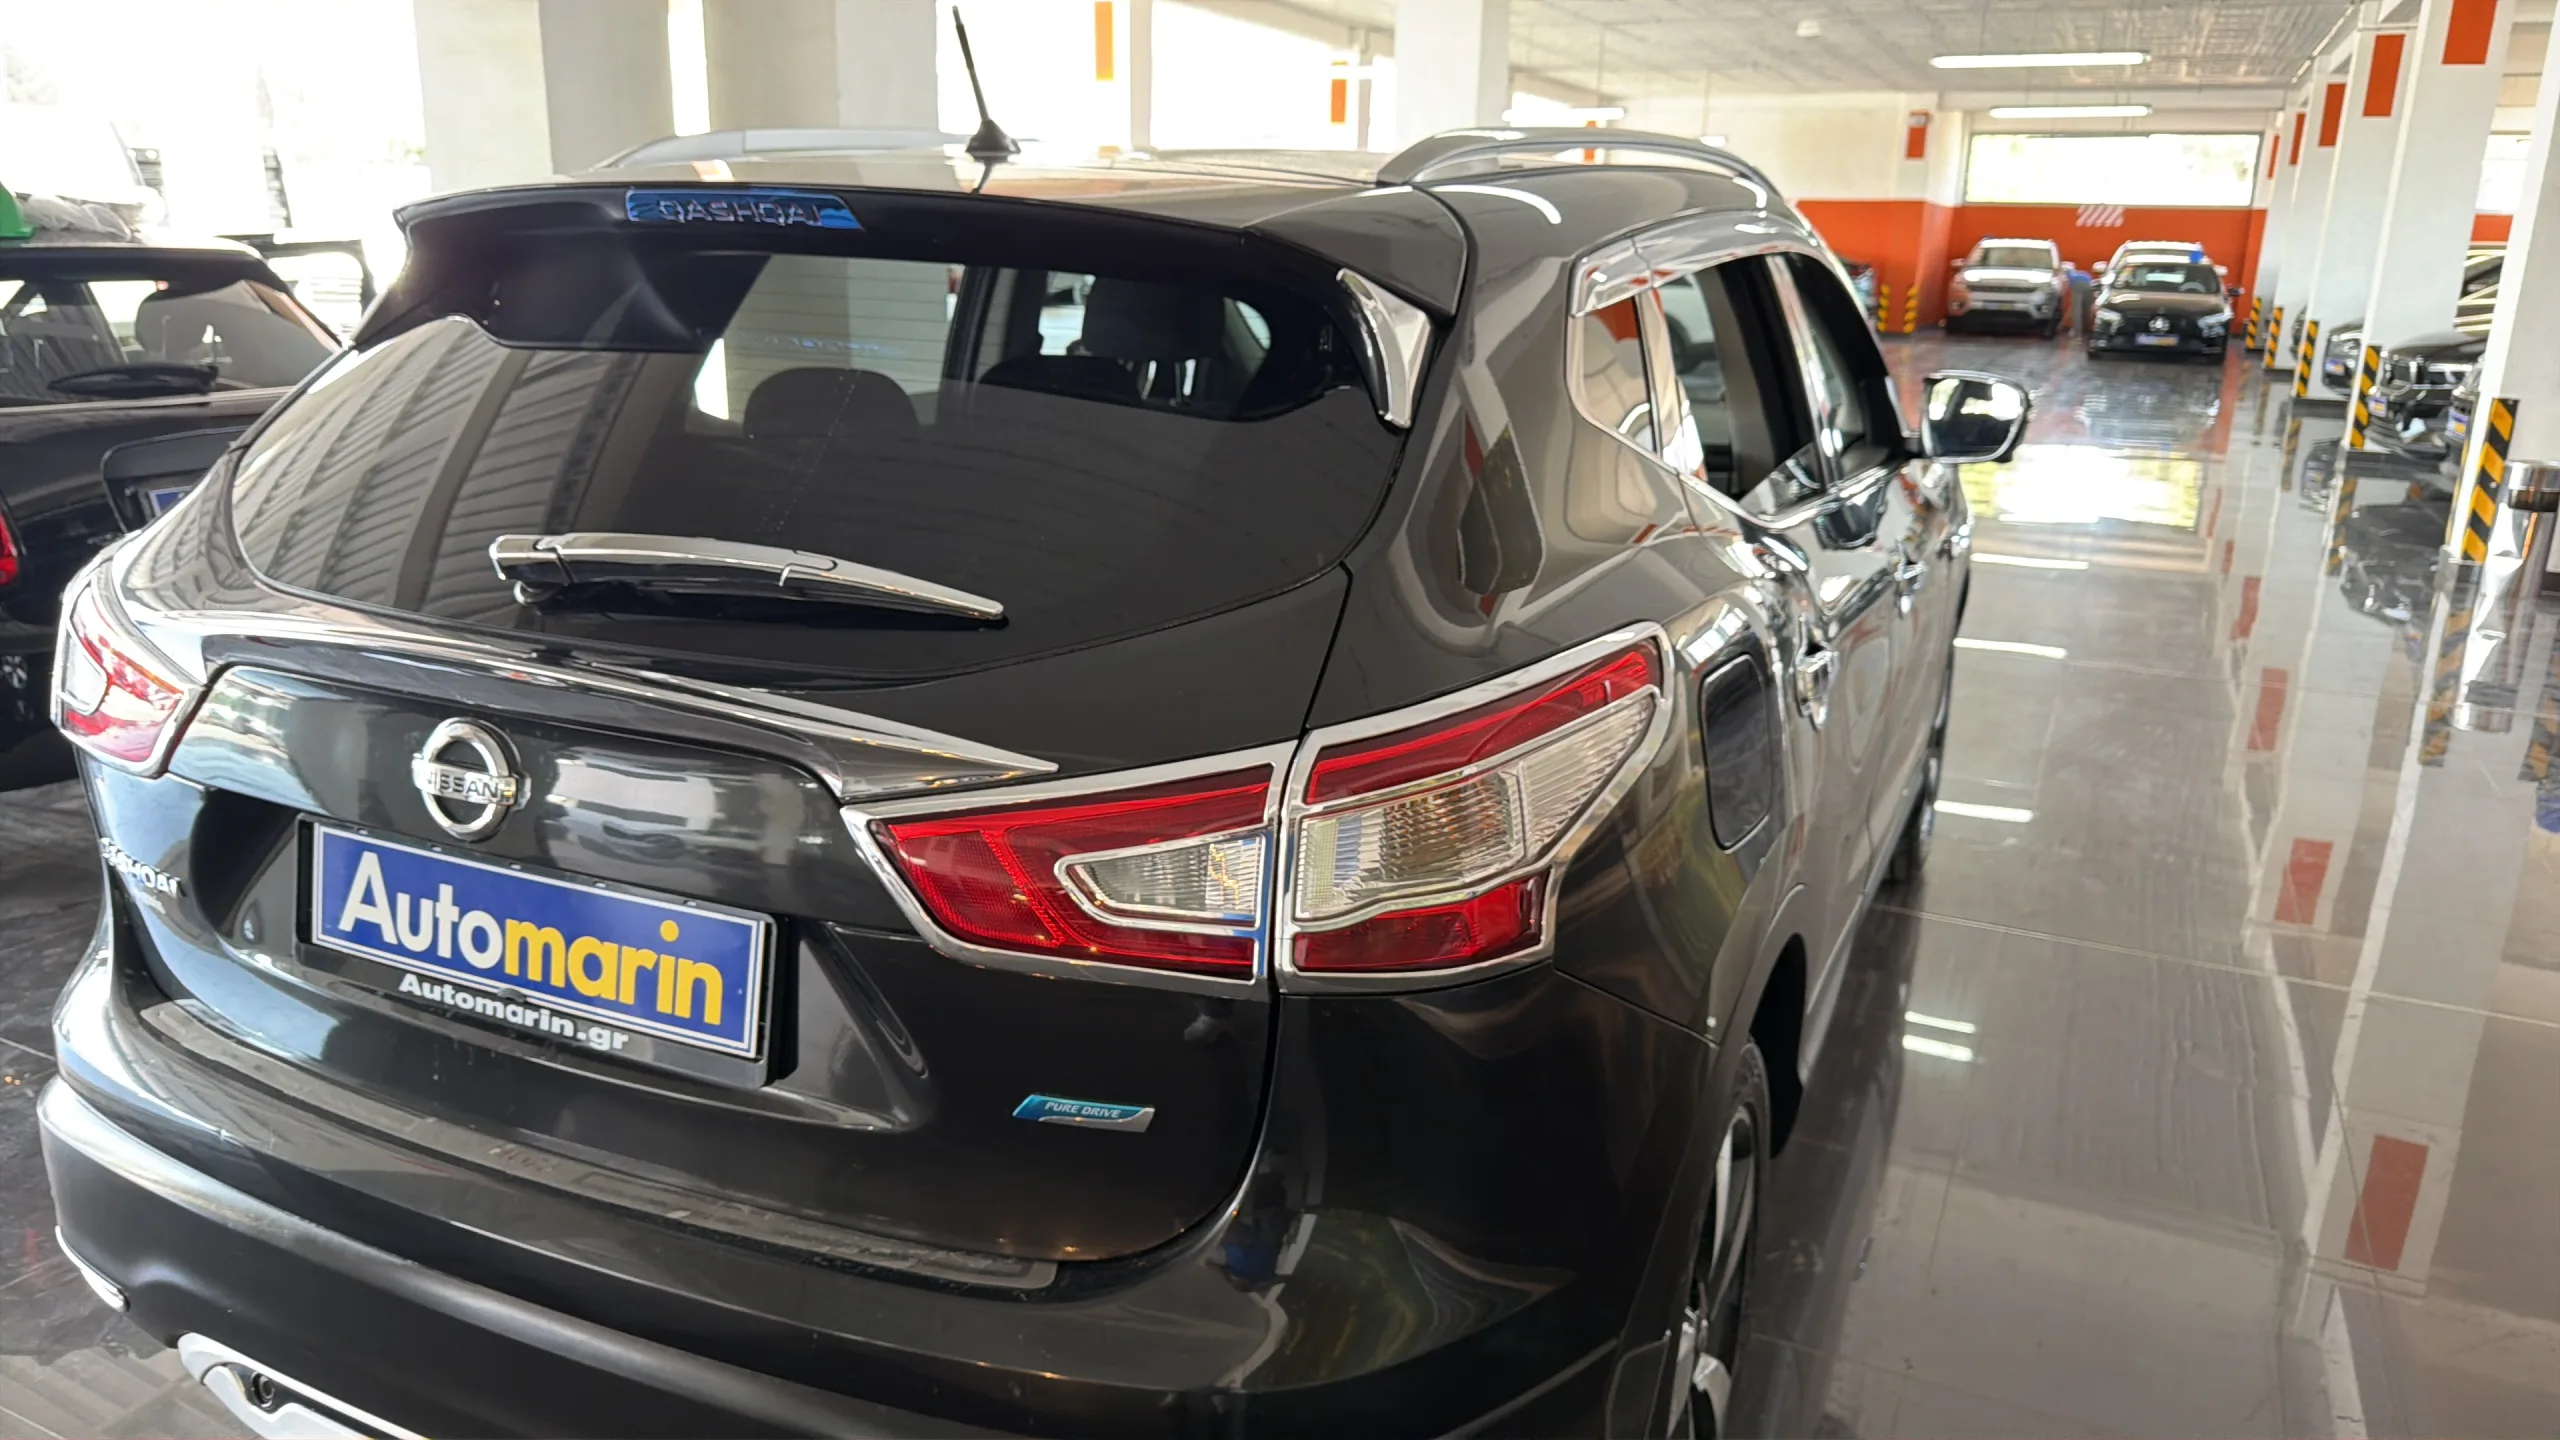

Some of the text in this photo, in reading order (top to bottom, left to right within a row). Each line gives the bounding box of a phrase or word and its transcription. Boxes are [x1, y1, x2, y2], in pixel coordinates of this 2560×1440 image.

[657, 198, 824, 226] QASHQAI
[338, 850, 724, 1026] Automarin
[398, 973, 630, 1051] Automarin.gr
[1044, 1101, 1122, 1118] PURE DRIVE
